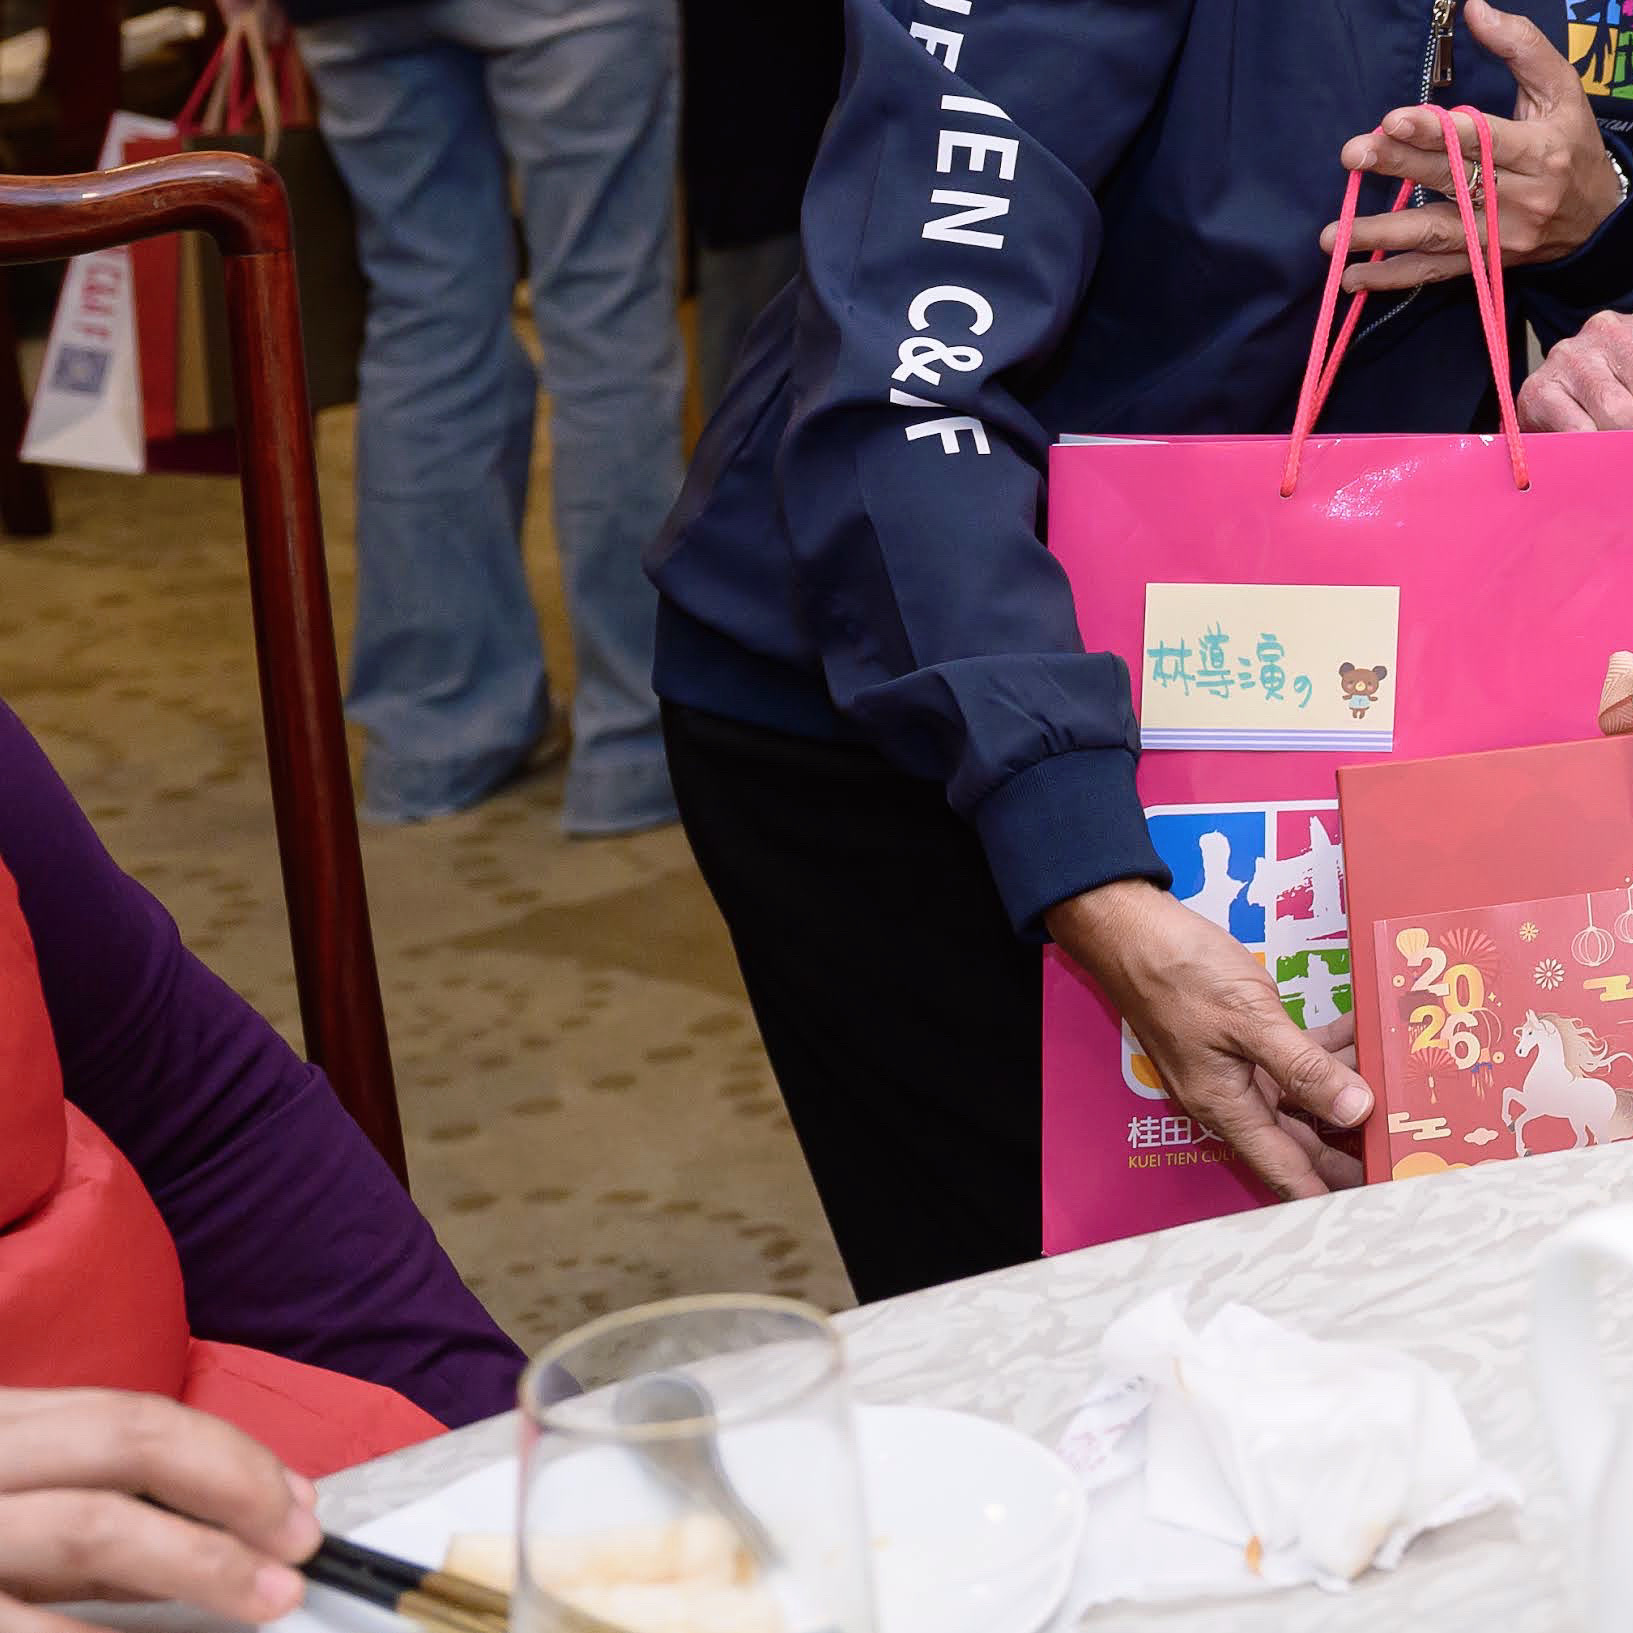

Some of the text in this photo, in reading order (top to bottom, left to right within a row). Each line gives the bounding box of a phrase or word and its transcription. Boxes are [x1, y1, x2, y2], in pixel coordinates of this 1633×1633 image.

[1127, 1116, 1225, 1149] 桂田文
[1128, 1154, 1161, 1169] KUEI
[1165, 1151, 1198, 1166] TIEN
